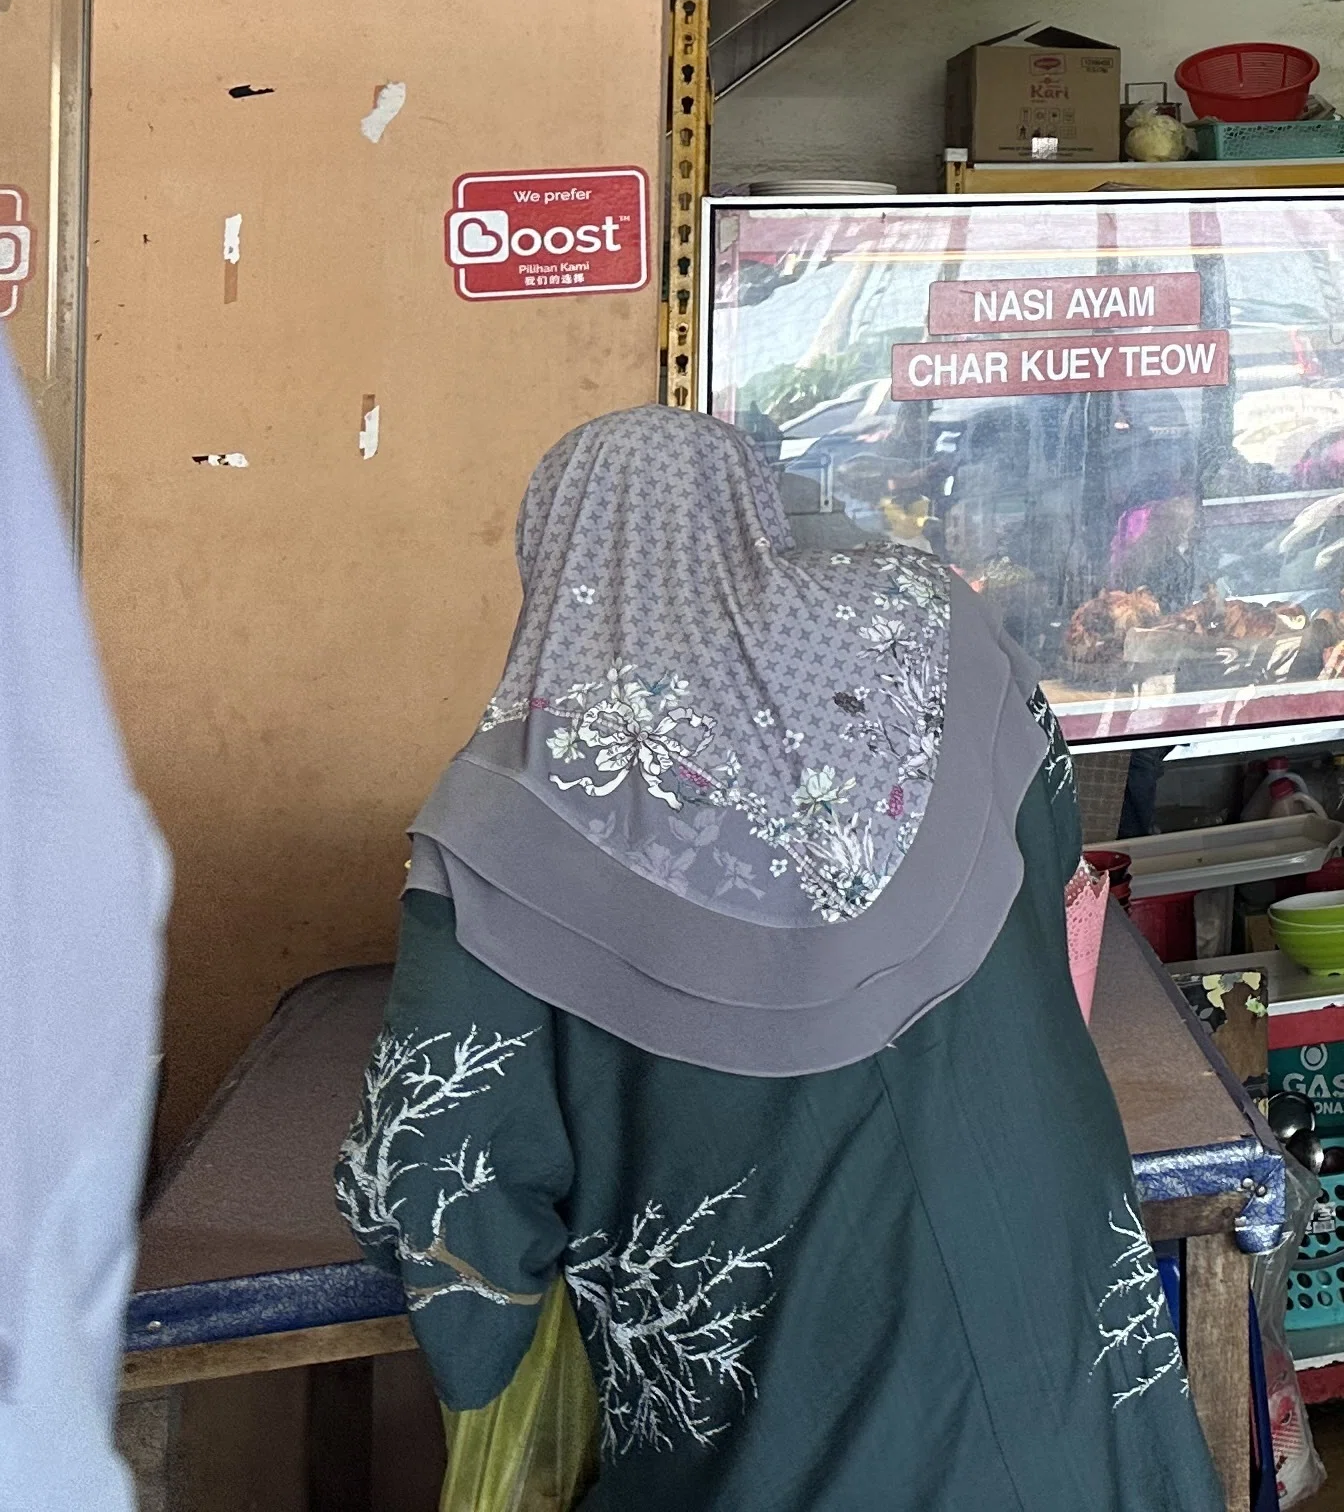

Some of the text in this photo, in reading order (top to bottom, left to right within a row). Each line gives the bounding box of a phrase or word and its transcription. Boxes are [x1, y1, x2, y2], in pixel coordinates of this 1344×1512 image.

[514, 188, 592, 204] We prefer
[519, 262, 589, 274] Pilihan Kami
[973, 286, 1155, 322] NASI AYAM
[908, 343, 1217, 388] CHAR KUEY TEOW
